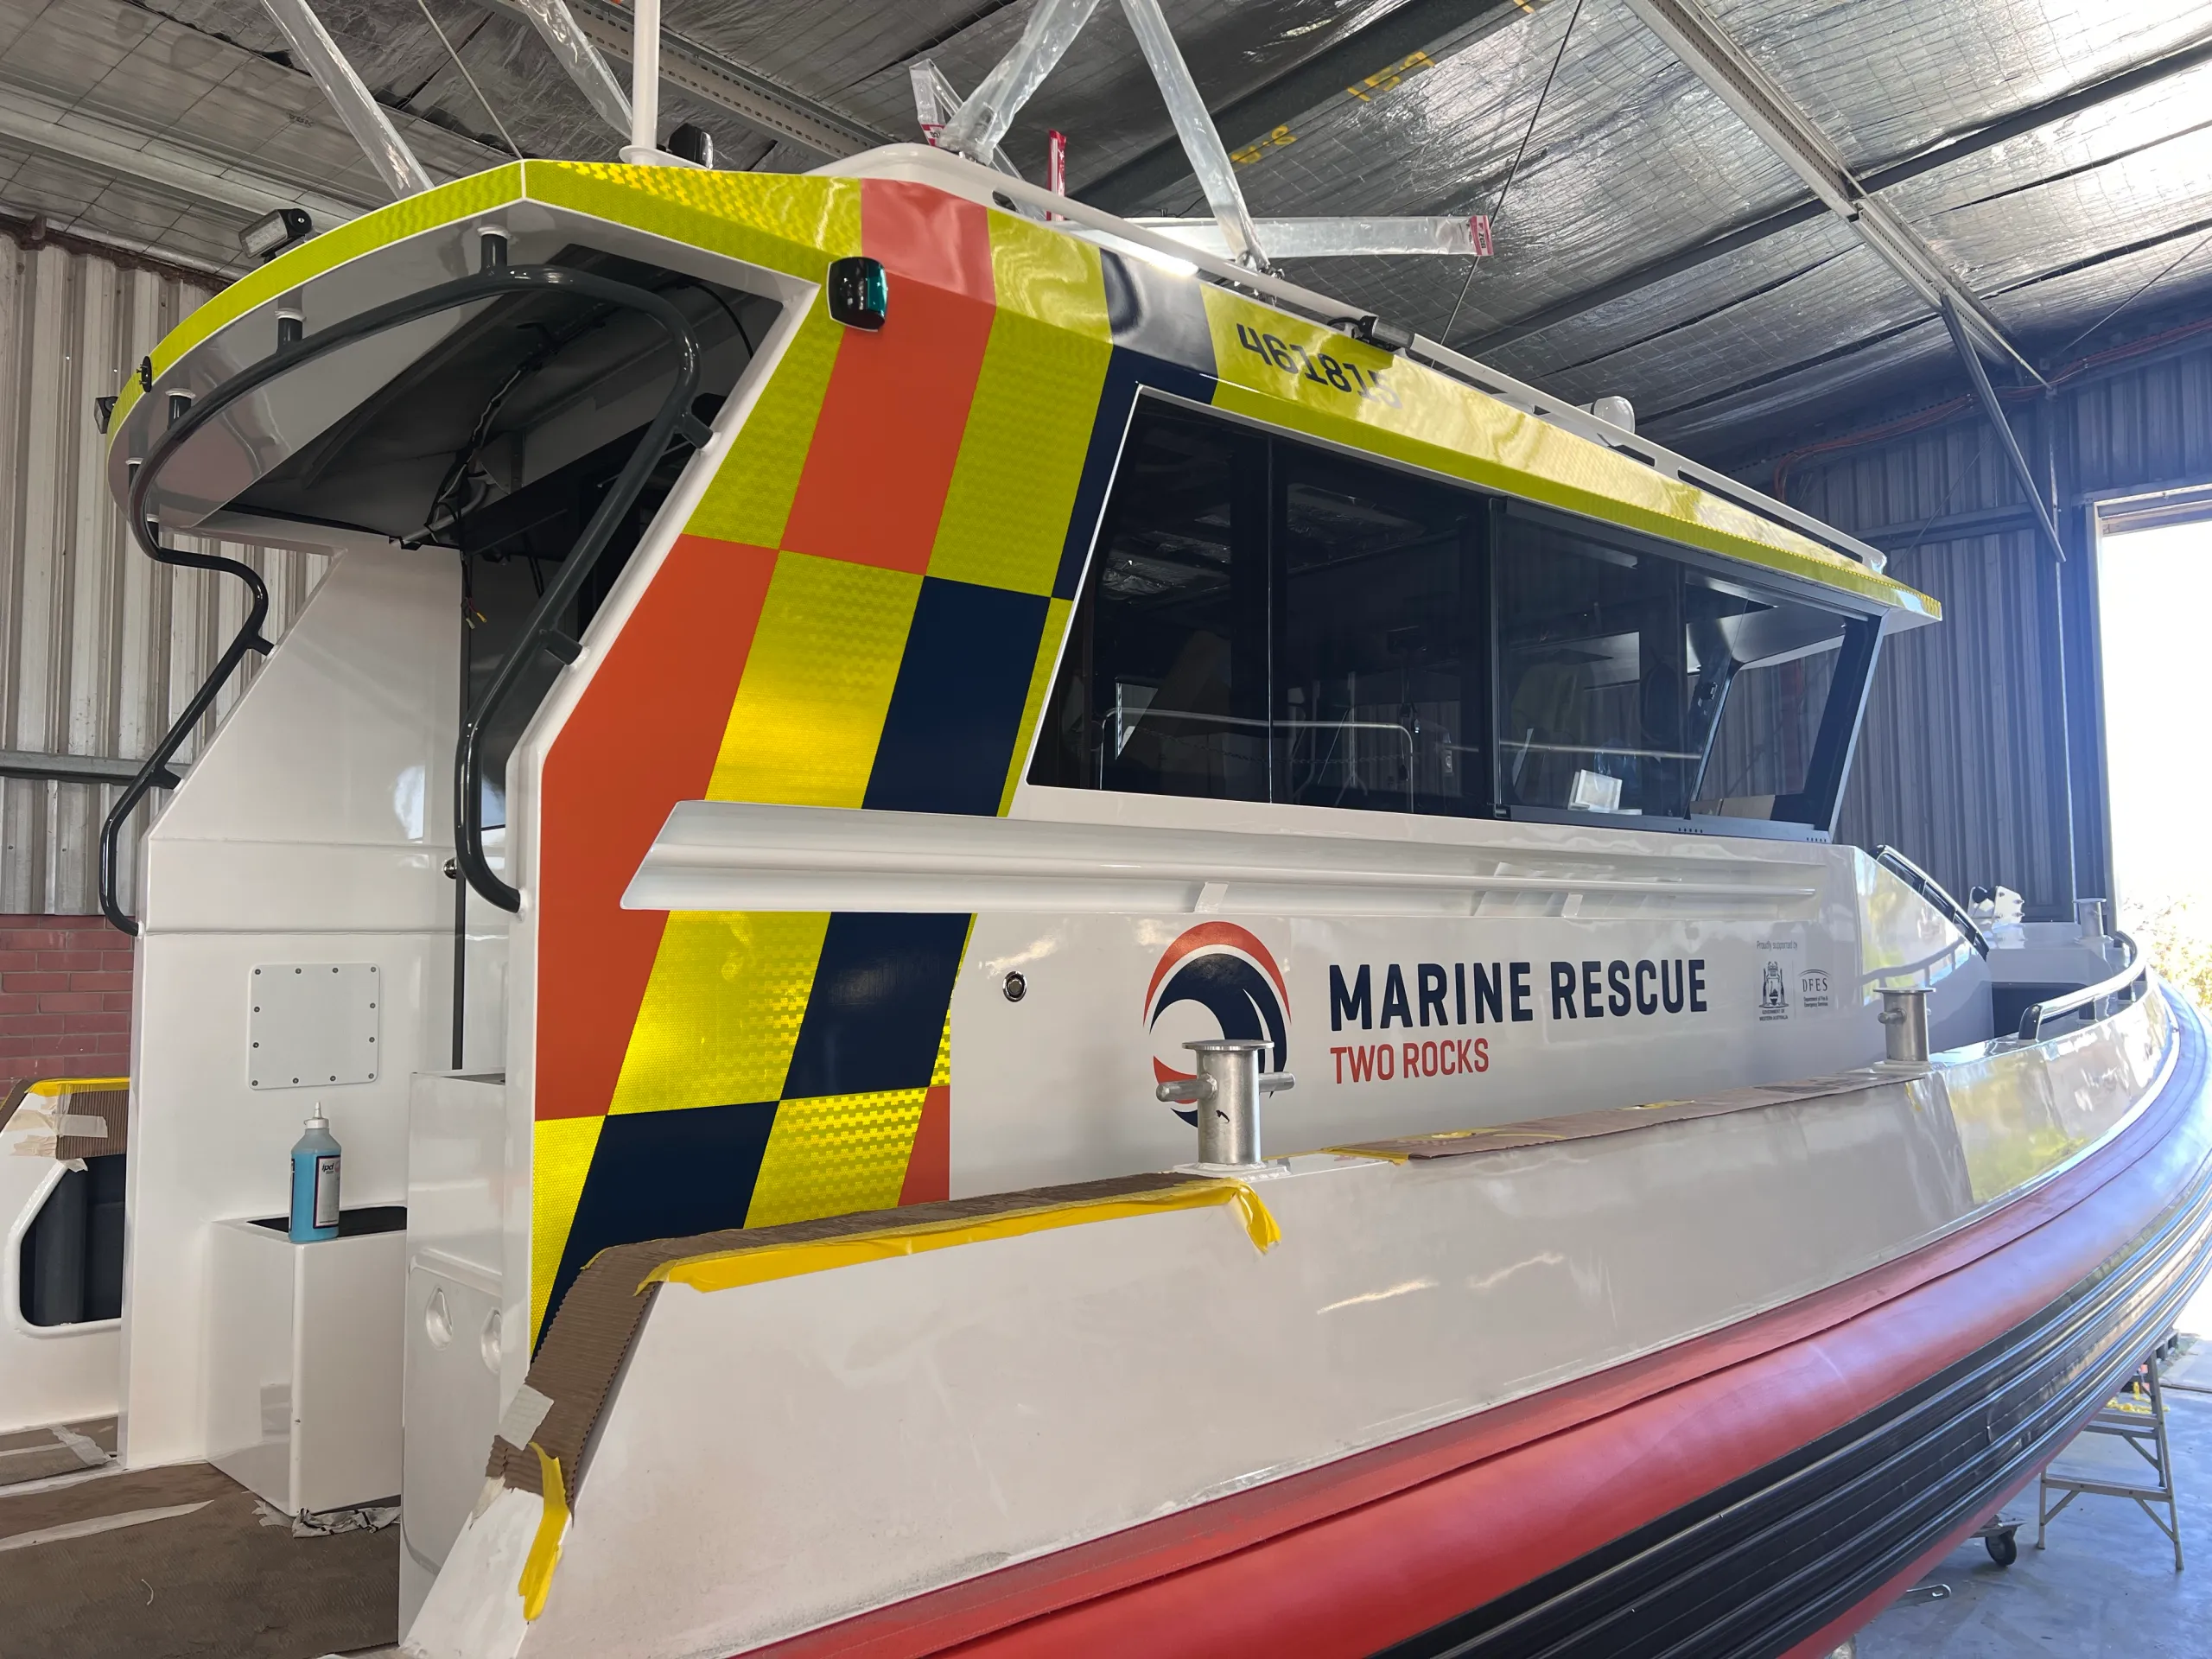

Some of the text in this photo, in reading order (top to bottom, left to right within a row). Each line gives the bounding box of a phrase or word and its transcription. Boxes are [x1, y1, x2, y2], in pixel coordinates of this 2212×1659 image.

[1330, 959, 1707, 1031] MARINE RESCUE
[1802, 977, 1827, 992] DFES
[1330, 1039, 1490, 1084] TWO ROCKS
